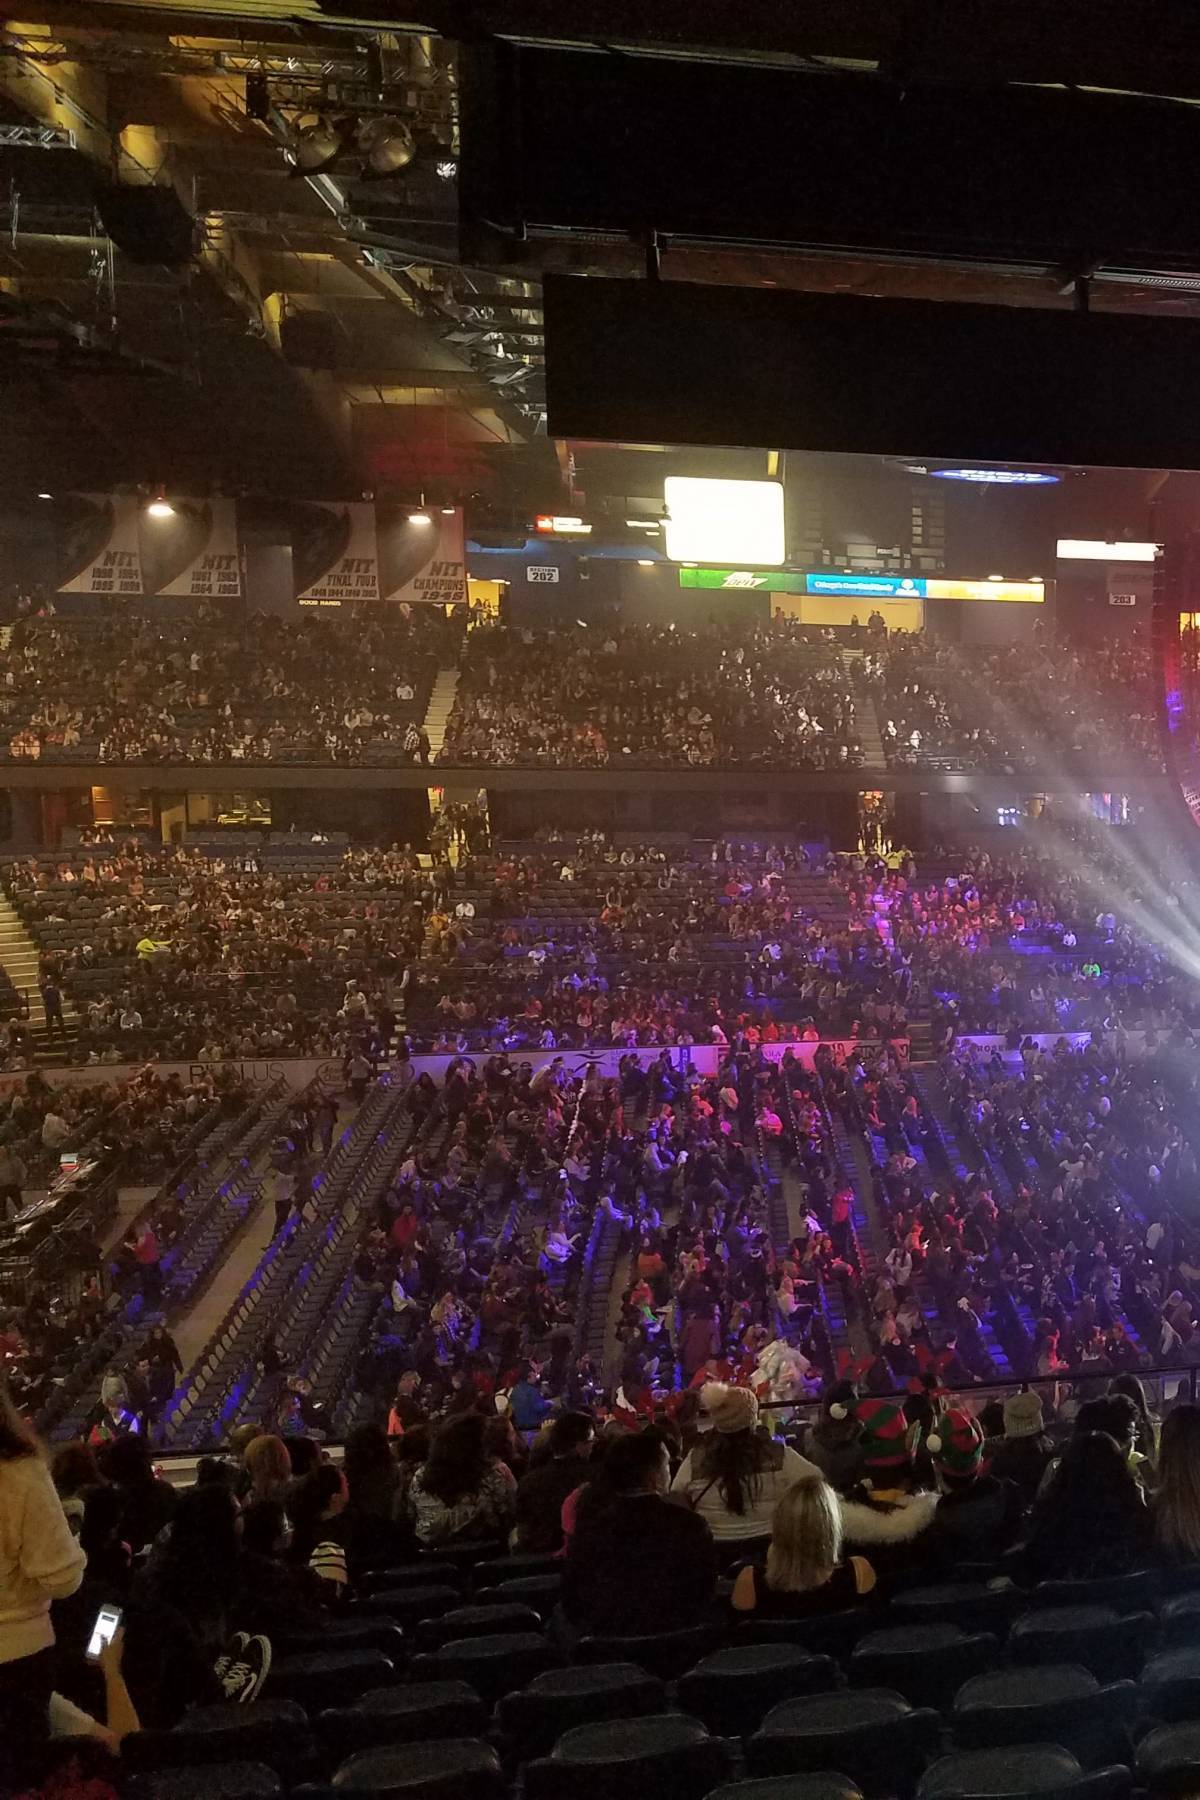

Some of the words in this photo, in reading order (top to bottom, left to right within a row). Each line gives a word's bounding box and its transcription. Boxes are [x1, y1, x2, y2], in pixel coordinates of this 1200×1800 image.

[340, 559, 374, 573] NIT
[429, 561, 463, 576] NIT
[327, 574, 352, 586] FINAL
[355, 575, 376, 587] FOUR
[532, 572, 553, 582] 202
[414, 579, 464, 591] CHAMPIONS
[1114, 596, 1131, 604] 203
